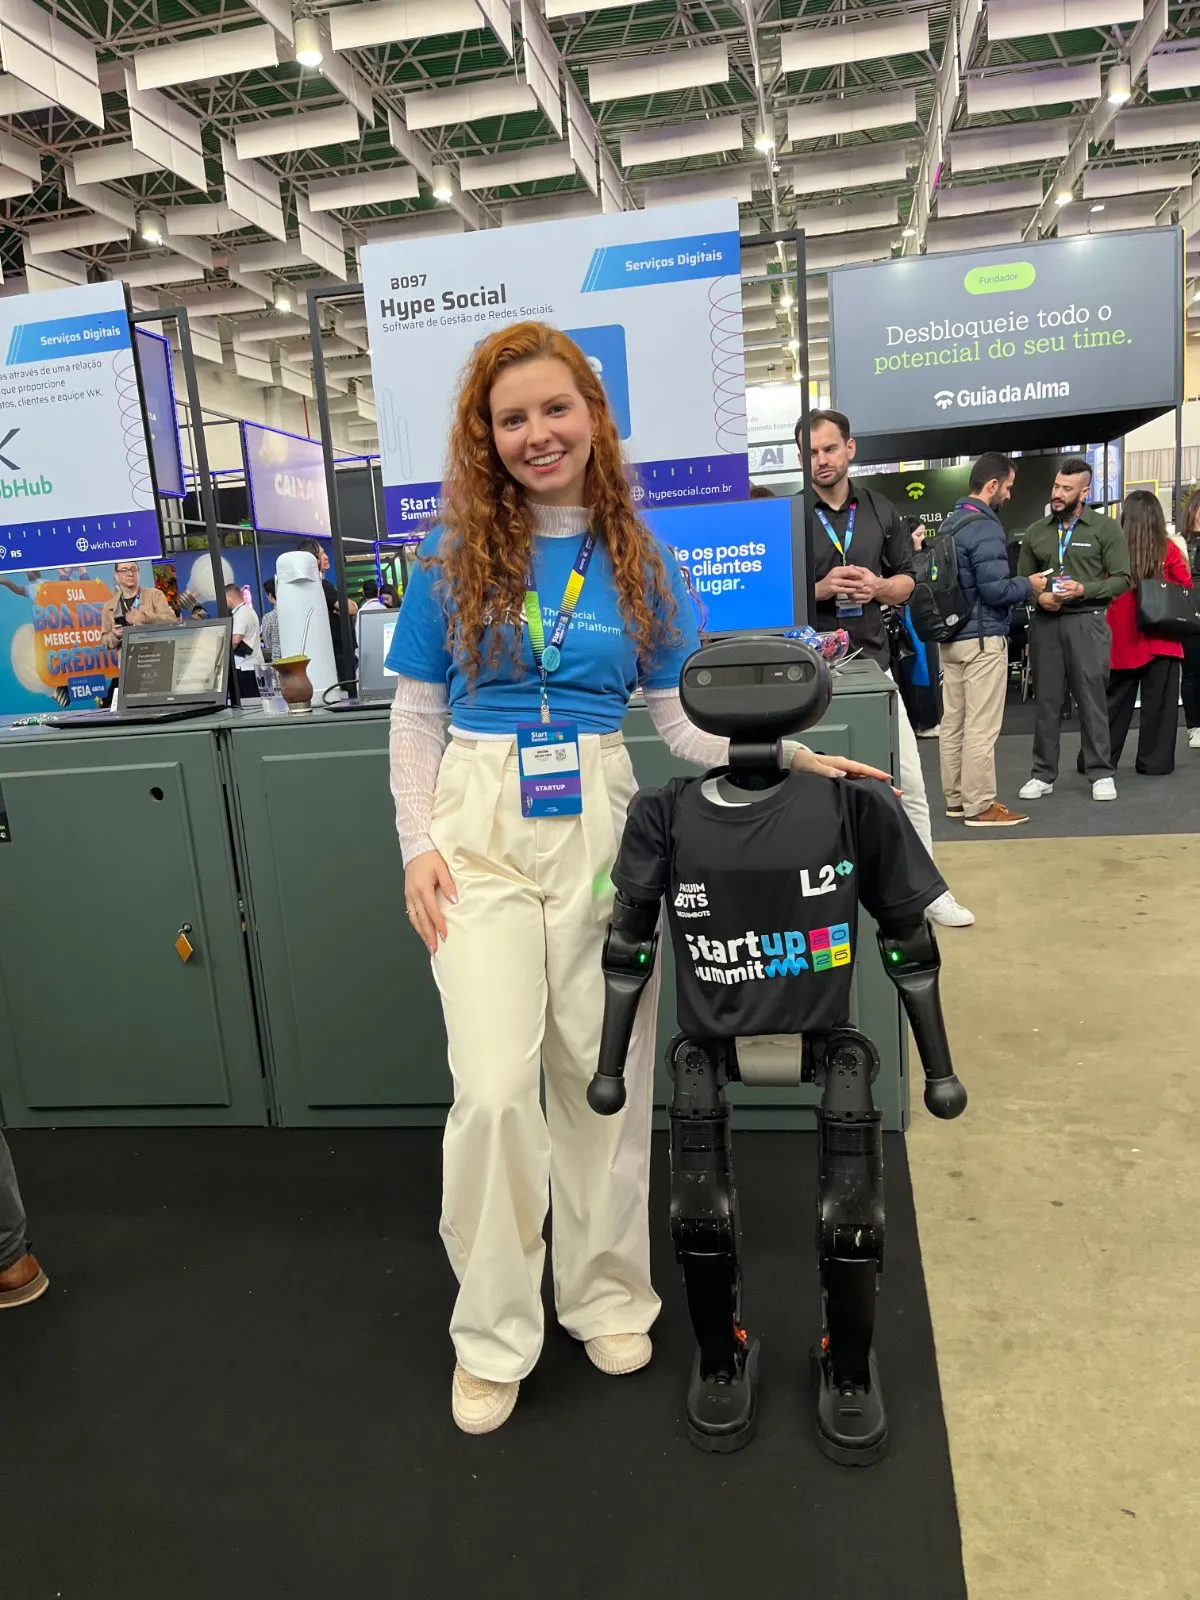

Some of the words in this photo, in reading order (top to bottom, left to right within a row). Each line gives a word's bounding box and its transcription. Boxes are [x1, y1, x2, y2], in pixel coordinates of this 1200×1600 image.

[625, 259, 675, 272] Serviços
[677, 249, 723, 267] Digitais
[390, 273, 427, 290] B097
[978, 272, 1018, 284] Fundador
[379, 295, 435, 321] Hype
[441, 283, 507, 310] Social
[382, 319, 424, 333] Software
[427, 317, 437, 327] de
[439, 312, 473, 325] Gestão
[474, 311, 486, 322] de
[488, 308, 517, 320] Redes
[519, 303, 555, 317] Sociais.
[886, 310, 1029, 347] Desbloqueie
[1036, 304, 1091, 329] todo
[1098, 303, 1113, 322] o
[40, 331, 81, 346] Serviços
[83, 326, 121, 343] Digitais
[874, 341, 981, 374] potencial
[988, 338, 1015, 359] do
[1024, 336, 1066, 356] seu
[1072, 325, 1133, 350] time.
[9, 368, 39, 380] através
[40, 367, 51, 375] de
[52, 364, 71, 373] uma
[72, 360, 102, 371] relação
[1, 386, 16, 395] que
[18, 380, 66, 394] proporcione
[957, 386, 997, 408] Guia
[998, 382, 1021, 403] da
[1023, 381, 1070, 401] Alma
[18, 397, 49, 407] clientes
[57, 391, 85, 402] equipe
[0, 474, 53, 499] bHub
[274, 472, 314, 500] CAIXA
[649, 484, 733, 501] hypesocial.com.br
[919, 513, 943, 522] sua
[90, 538, 138, 551] wkrh.com.br
[674, 548, 689, 562] ie
[692, 548, 713, 560] os
[716, 541, 766, 561] posts
[10, 549, 22, 559] RS
[692, 559, 763, 576] clientes
[66, 589, 86, 602] SUA
[695, 577, 745, 596] lugar.
[34, 603, 74, 631] BOA
[76, 602, 104, 628] IDE
[572, 608, 596, 620] ocial
[44, 631, 82, 647] MERECE
[82, 629, 103, 642] TOD
[578, 622, 621, 638] Platform
[71, 685, 92, 698] TEIA
[535, 784, 565, 792] STARTUP
[799, 864, 837, 897] L2
[674, 893, 709, 909] BOTS
[694, 960, 765, 985] ummit
